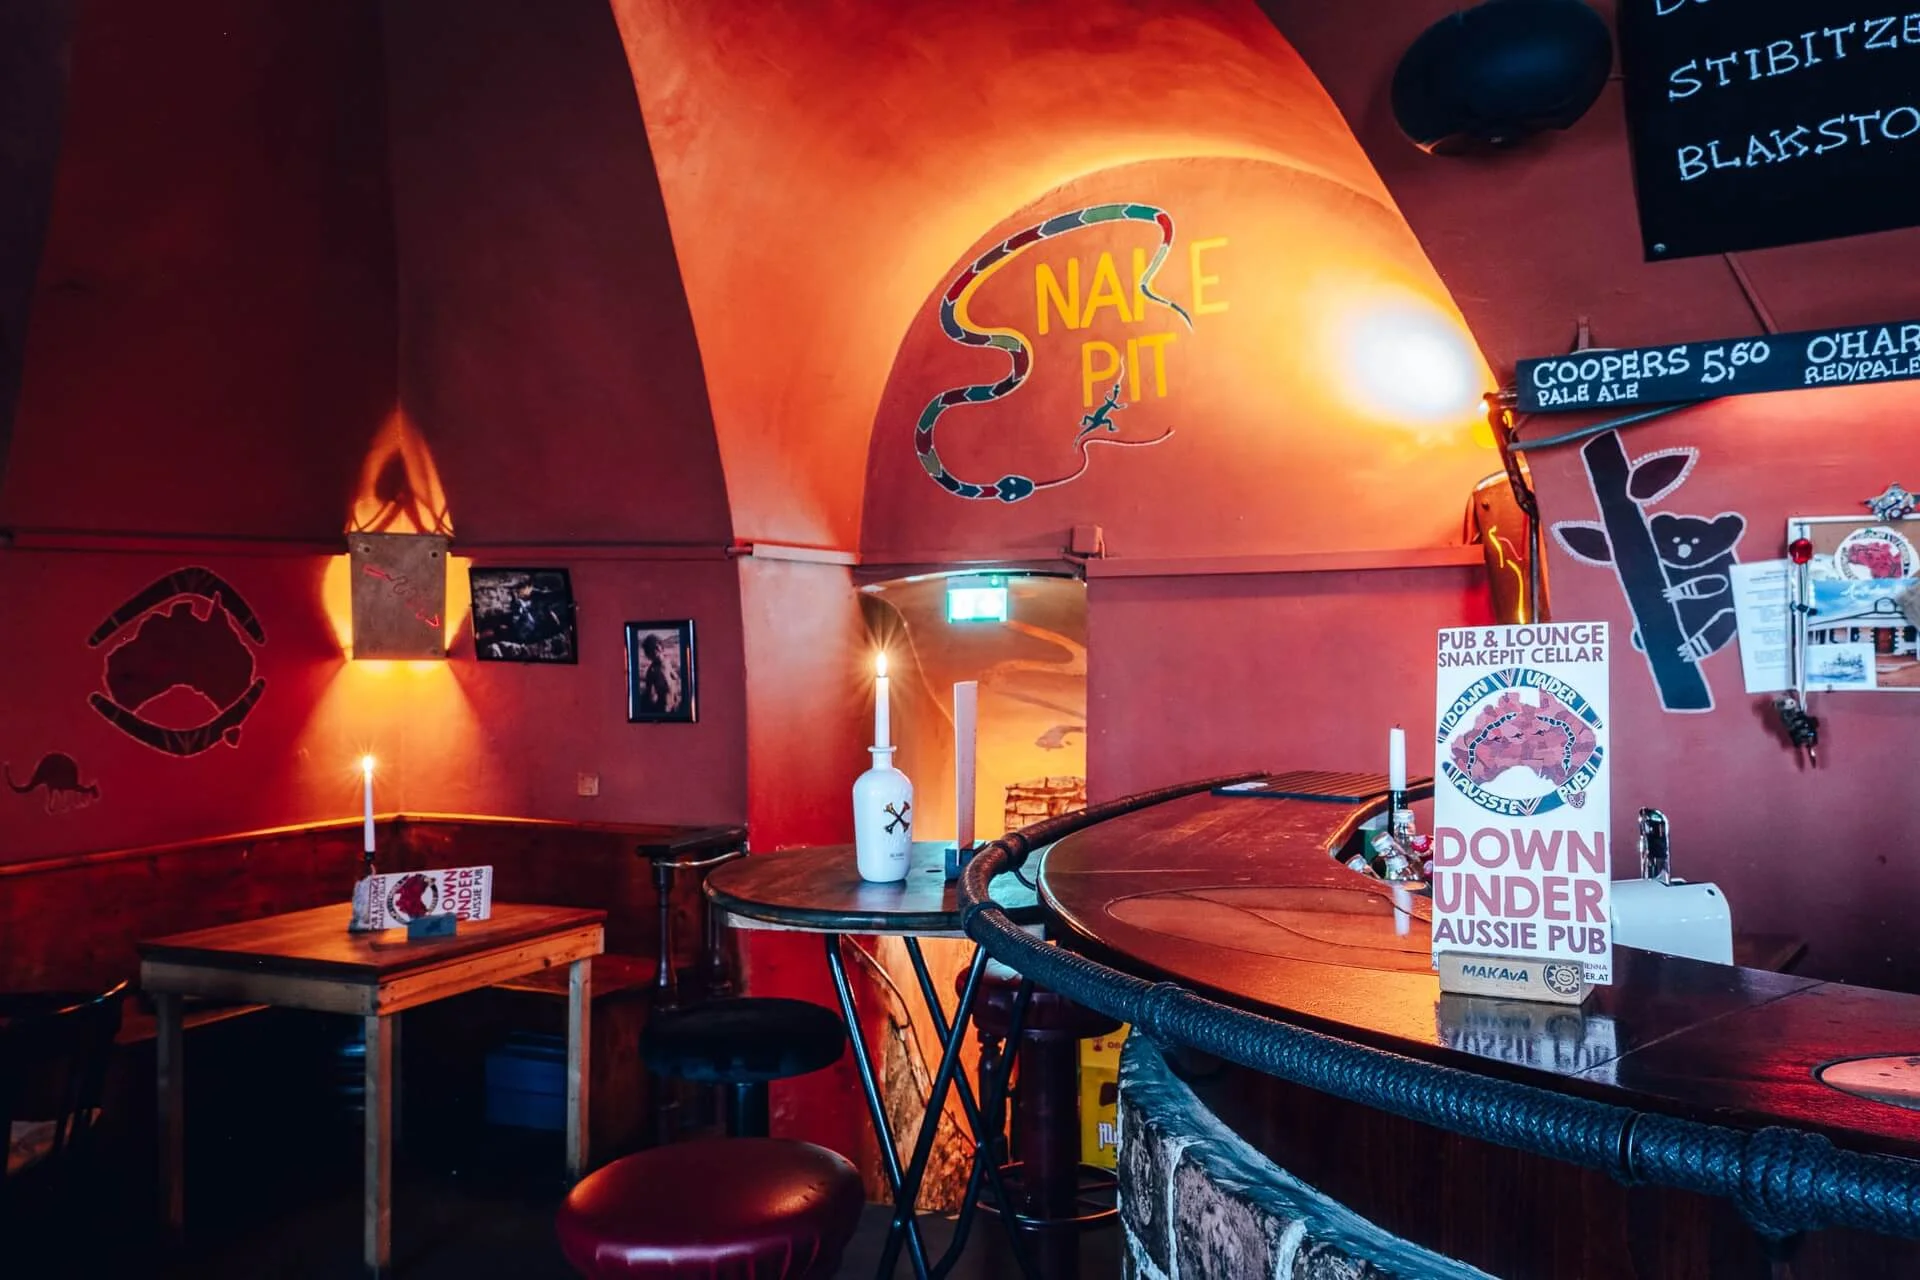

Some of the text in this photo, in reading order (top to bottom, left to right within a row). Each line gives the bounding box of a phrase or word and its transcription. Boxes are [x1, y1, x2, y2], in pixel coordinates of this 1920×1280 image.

[1669, 12, 1920, 101] STIBITZE
[1678, 106, 1920, 181] BLAKSTO
[1533, 340, 1771, 388] COOPERS 5,60
[1806, 323, 1920, 364] O'HAR
[1081, 332, 1177, 408] PIT
[1804, 355, 1920, 385] RED/PALE
[1536, 381, 1639, 407] PALE ALE
[1438, 624, 1605, 650] PUB & LOUNGE
[1438, 647, 1604, 667] SNAKEPIT CELLAR
[1446, 670, 1577, 728] DOWN UNDER
[1454, 770, 1591, 815] AUSSIE PUB
[1433, 826, 1606, 874] DOWN
[442, 870, 457, 911] OWN
[1434, 871, 1607, 923] UNDER
[1433, 918, 1606, 955] AUSSIE PUB
